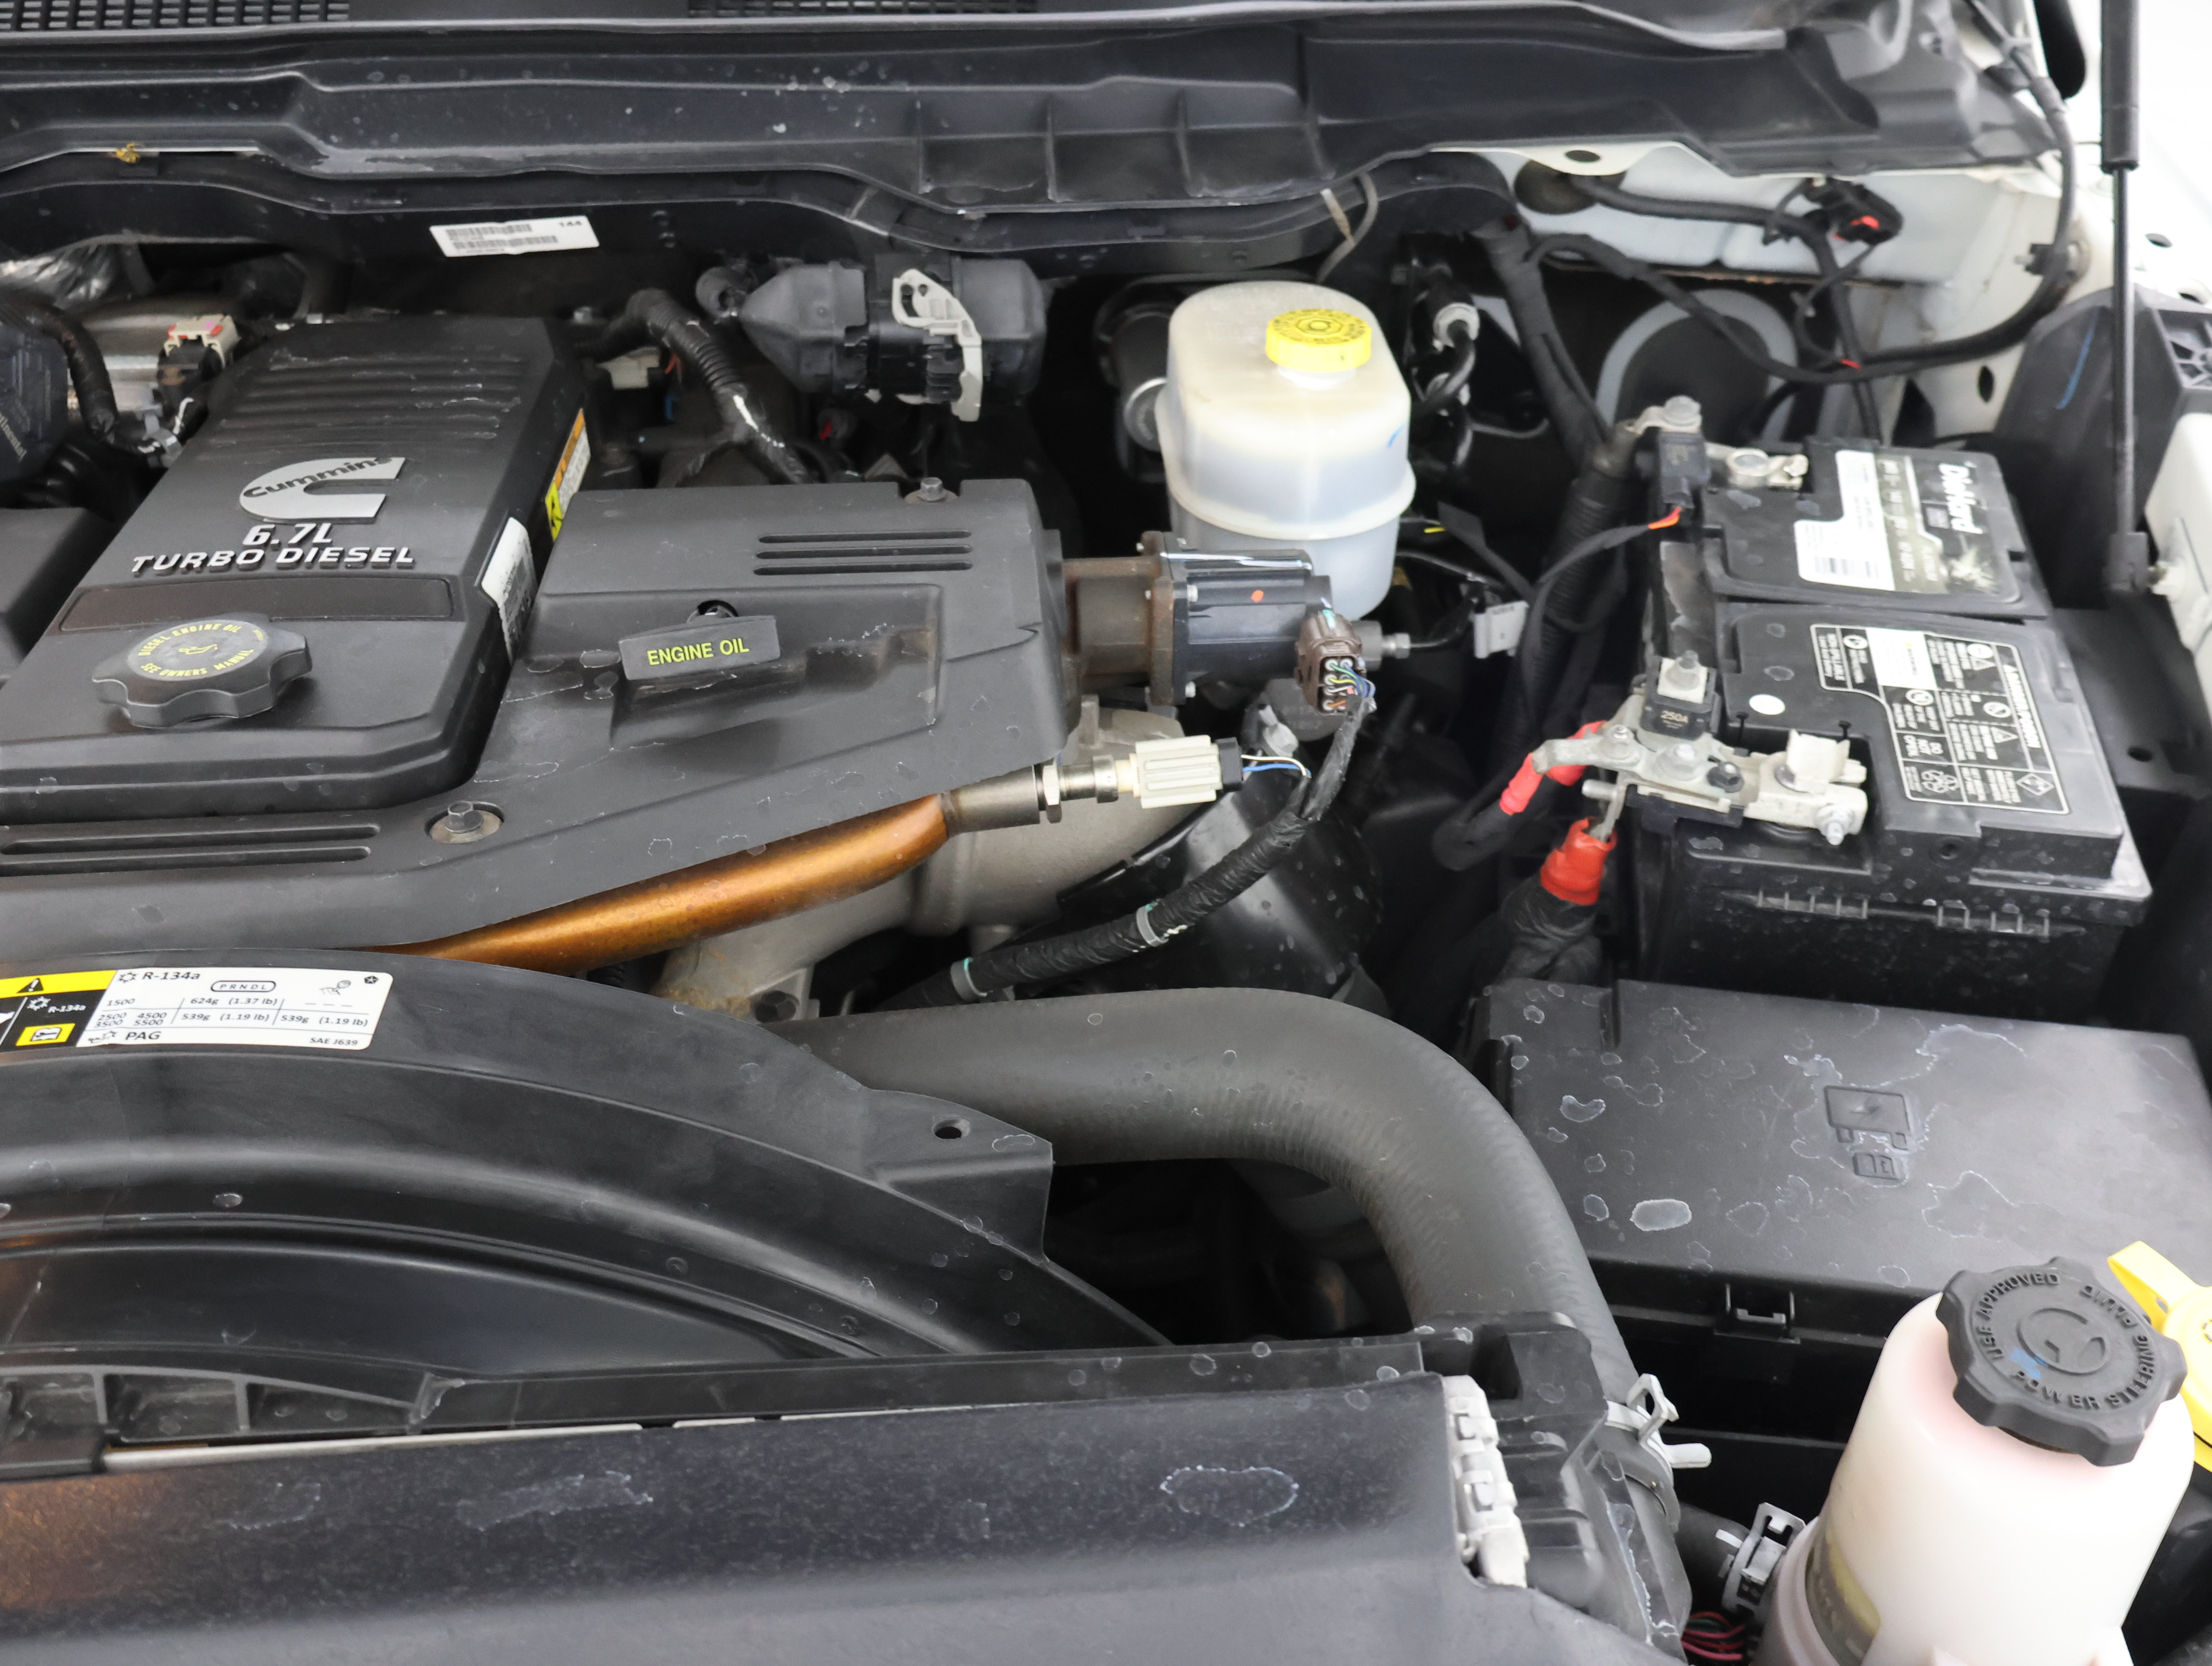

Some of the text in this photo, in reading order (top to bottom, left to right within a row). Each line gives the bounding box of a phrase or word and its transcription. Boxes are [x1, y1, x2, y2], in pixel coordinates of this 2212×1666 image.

[1938, 462, 1983, 535] DieHard
[242, 523, 332, 546] 6.7L
[132, 547, 415, 574] TURBO DIESEL
[138, 623, 243, 656] DIESEL ENGINE OIL
[647, 638, 750, 666] ENGINE OIL
[141, 649, 255, 676] SEE OWNERS MANUAL
[1917, 739, 1932, 755] NOT
[1929, 742, 1944, 754] DO
[142, 971, 201, 980] R-134a
[94, 1020, 123, 1028] 3500
[280, 1015, 368, 1027] 539g (1.19 lb)
[125, 1032, 161, 1040] PAG
[1976, 1273, 2060, 1360] USE APPROVED
[2010, 1370, 2099, 1410] POWER
[2104, 1334, 2155, 1408] STEERING
